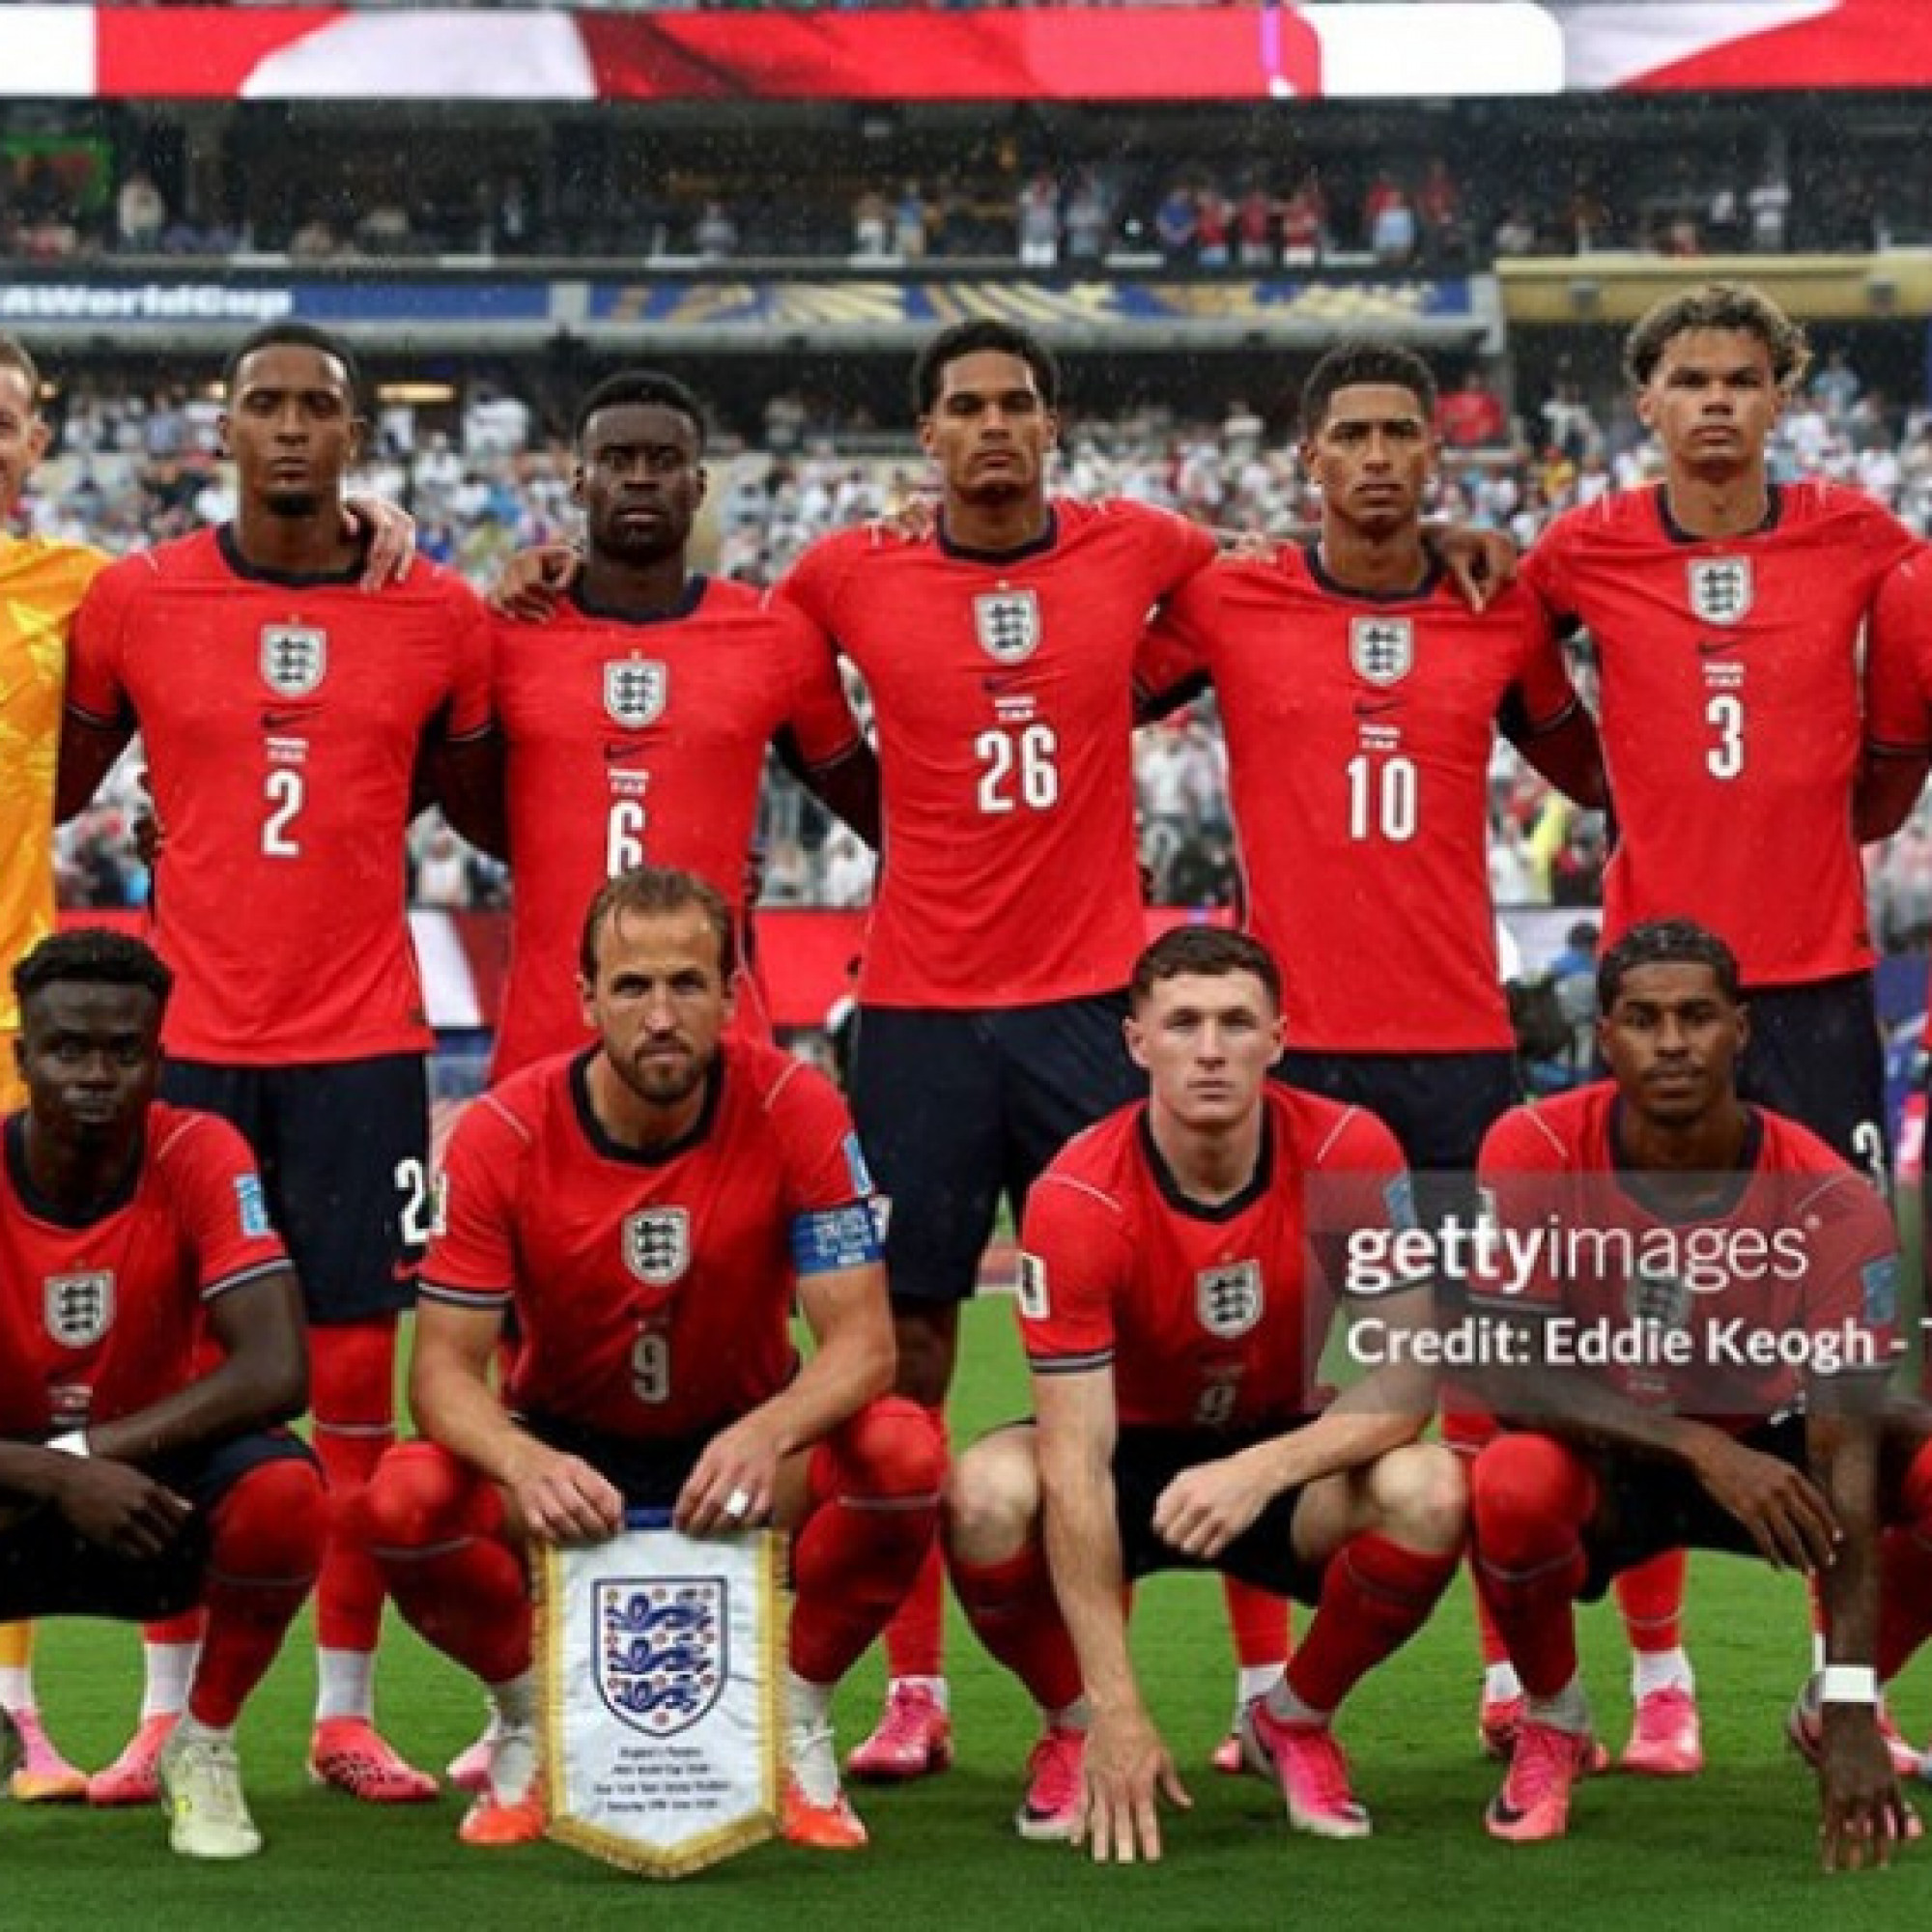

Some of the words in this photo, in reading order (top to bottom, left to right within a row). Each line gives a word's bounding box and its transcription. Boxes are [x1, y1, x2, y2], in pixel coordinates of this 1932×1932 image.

[974, 724, 1058, 814] 26
[1705, 693, 1745, 781] 3
[262, 769, 304, 857] 2
[608, 800, 645, 879] 6
[1346, 754, 1418, 841] 10
[394, 1157, 429, 1245] 2
[632, 1334, 669, 1404] 9
